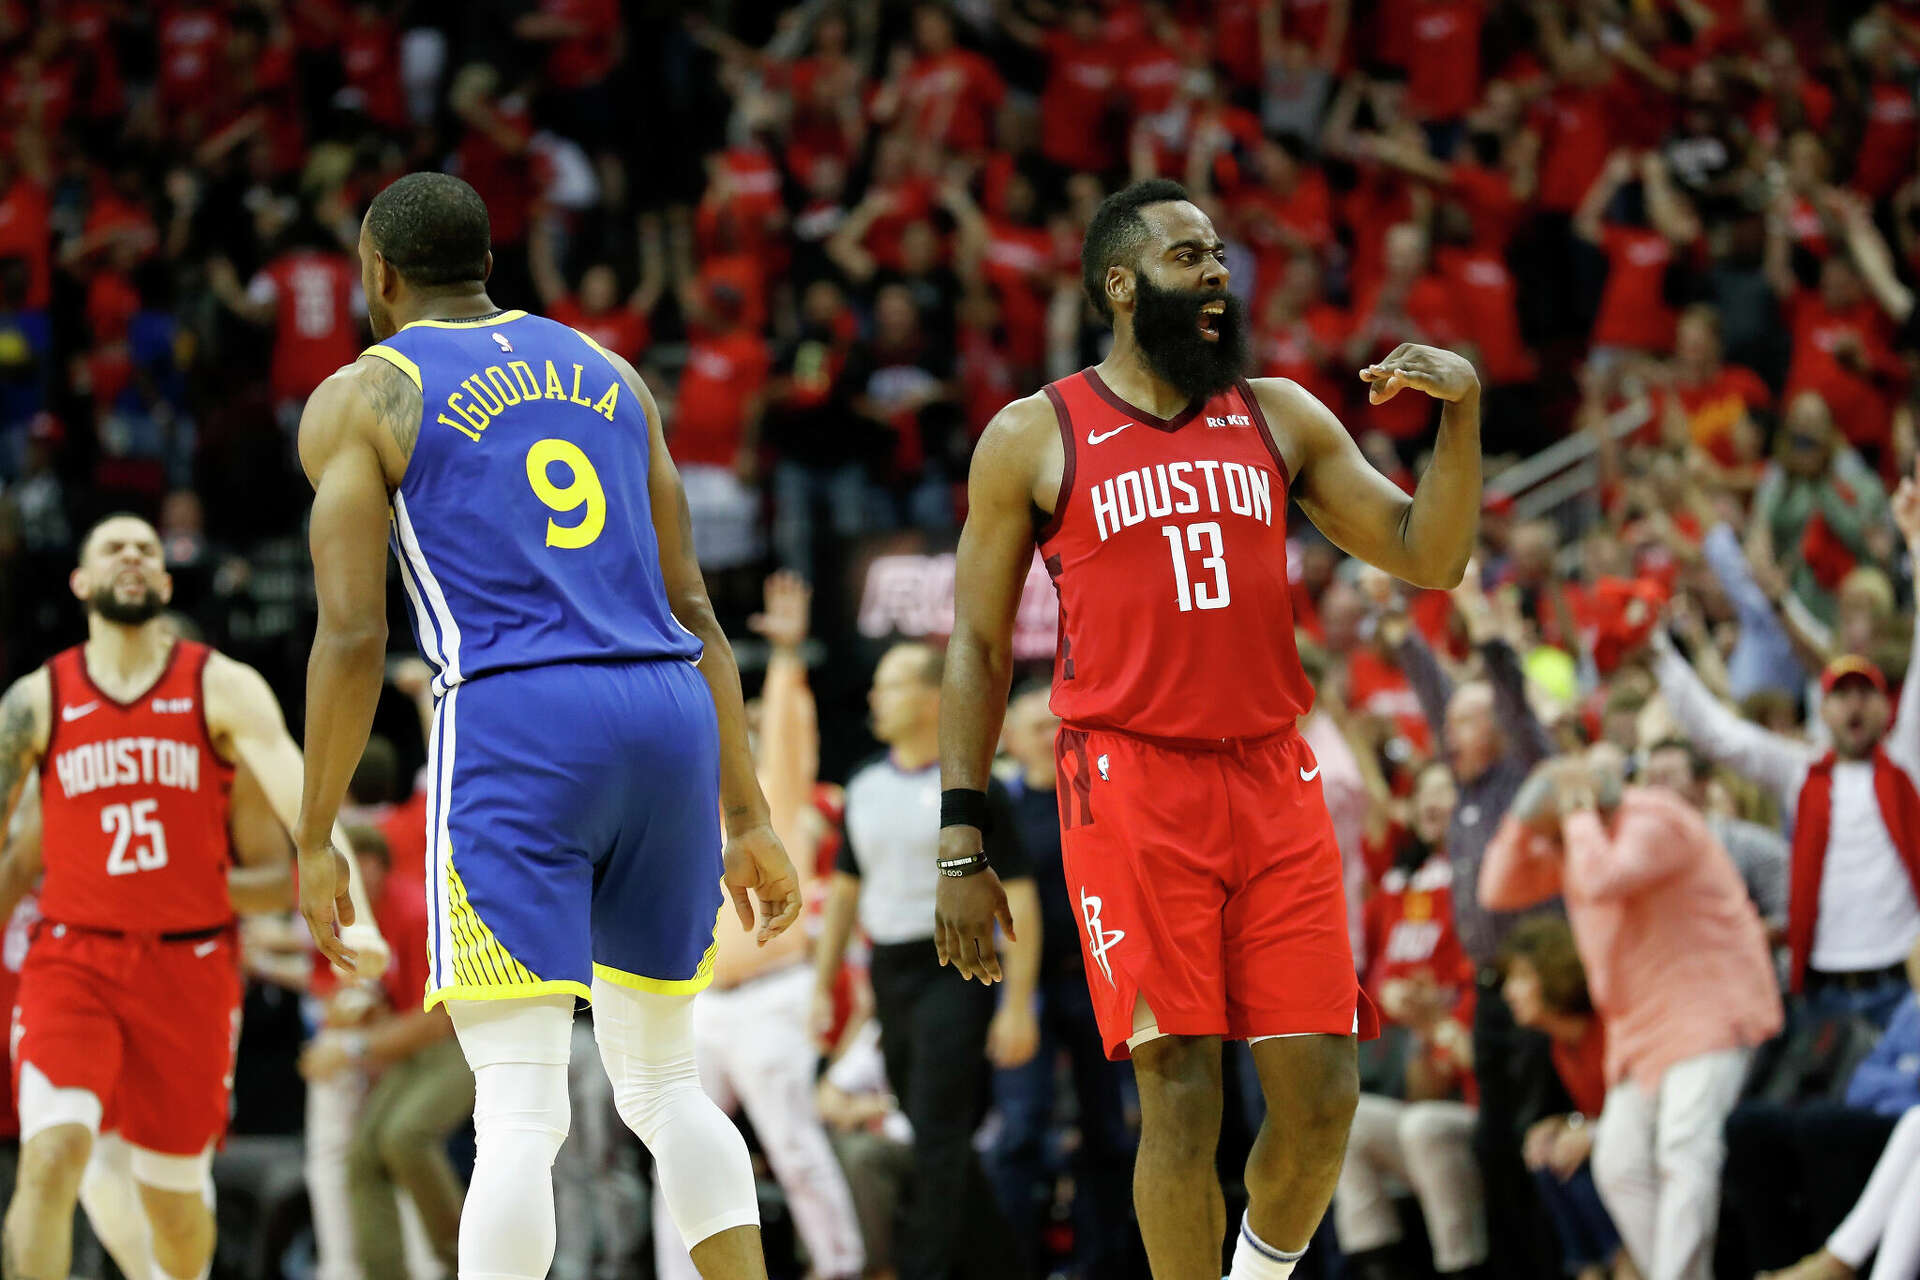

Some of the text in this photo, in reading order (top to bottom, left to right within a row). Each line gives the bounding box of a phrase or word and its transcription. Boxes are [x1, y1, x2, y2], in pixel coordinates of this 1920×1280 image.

[437, 360, 620, 442] IGUODALA
[526, 438, 607, 549] 9
[1090, 460, 1272, 542] HOUSTON
[1162, 521, 1231, 612] 13
[55, 736, 199, 799] HOUSTON
[101, 797, 168, 876] 25
